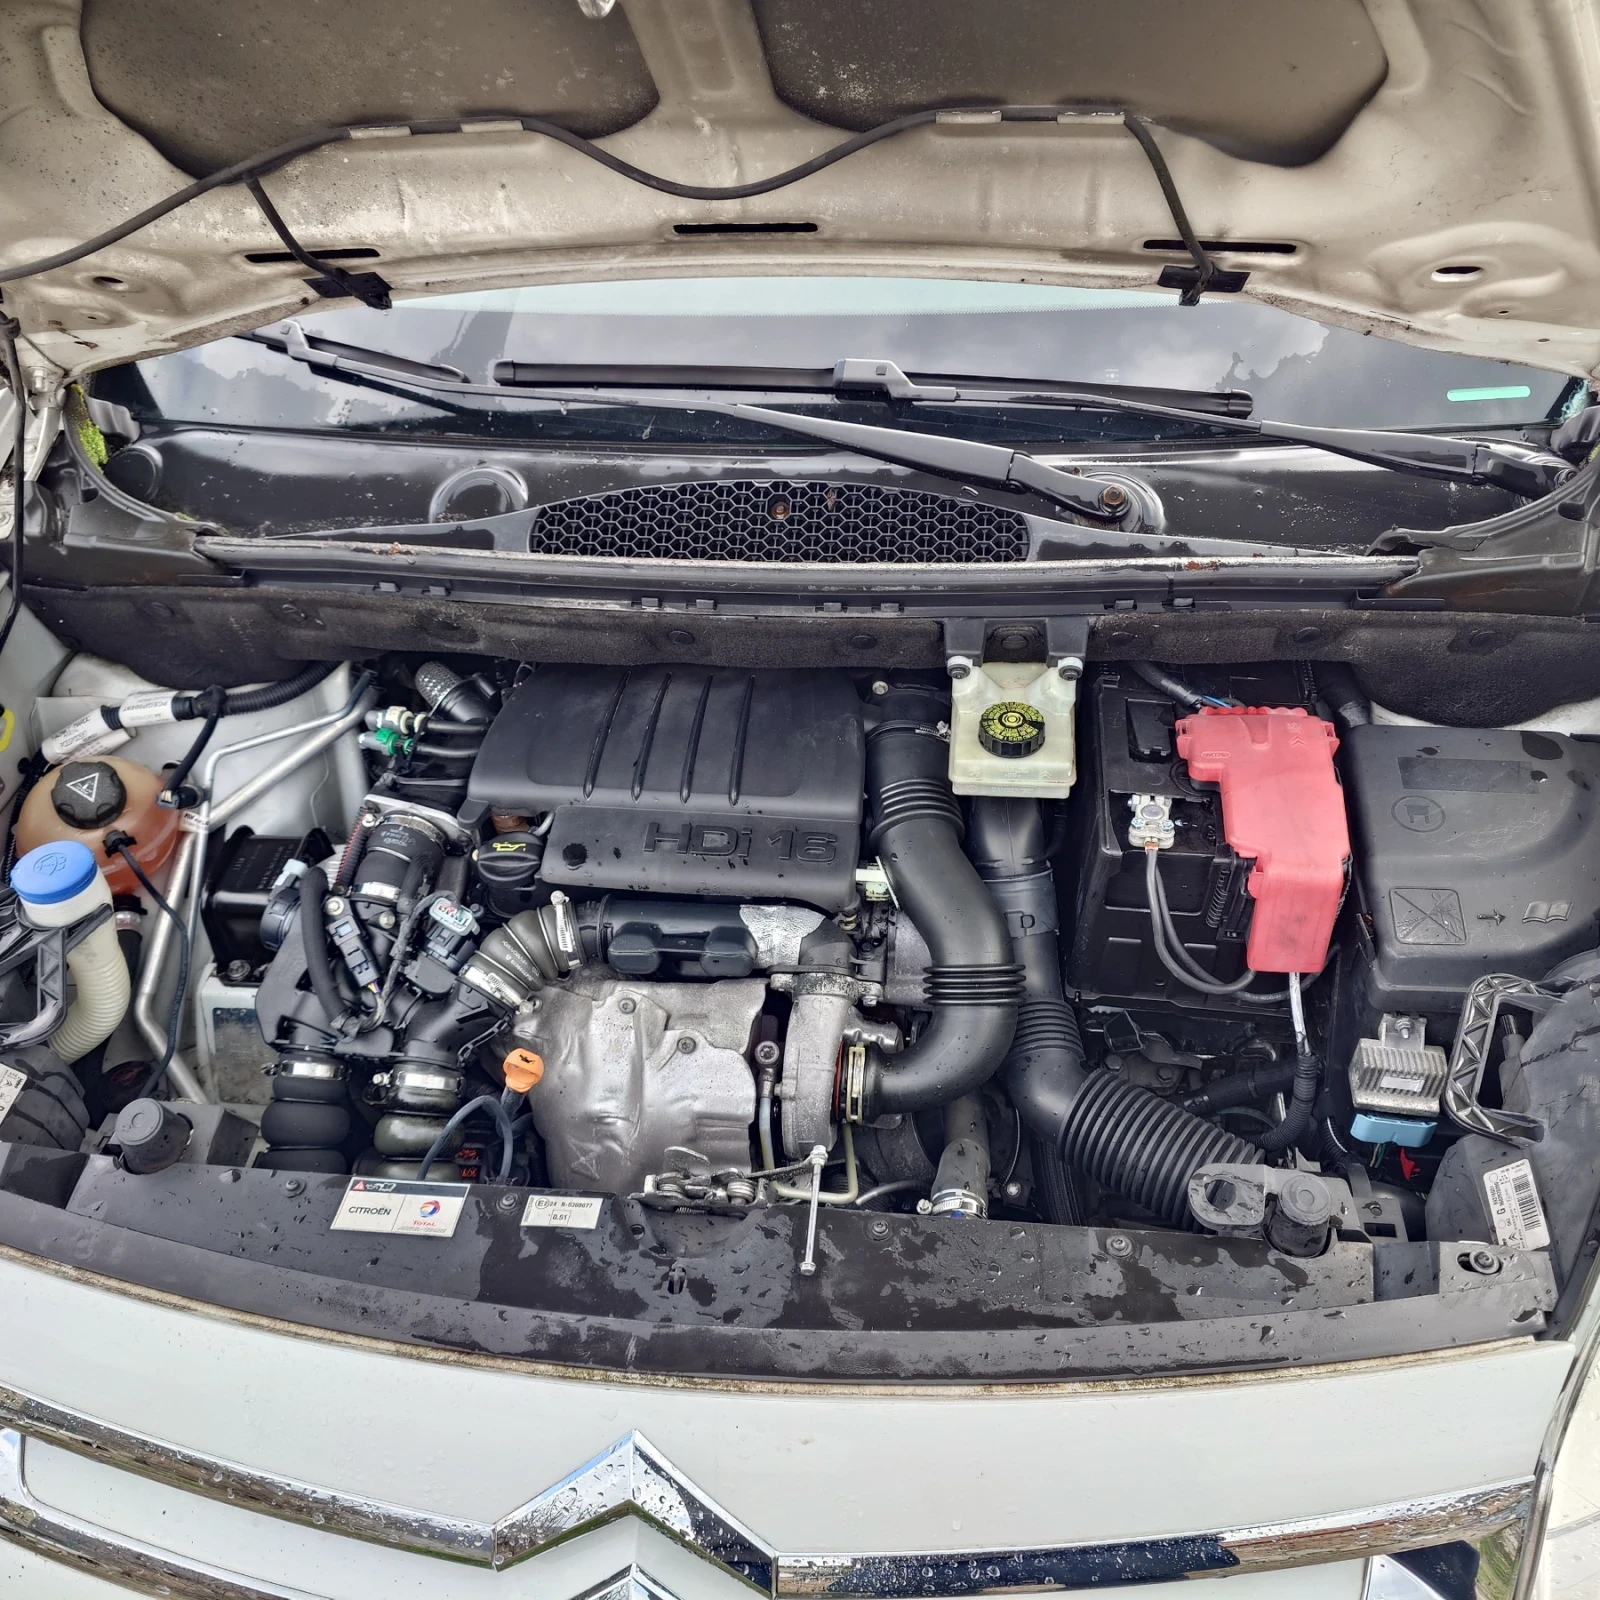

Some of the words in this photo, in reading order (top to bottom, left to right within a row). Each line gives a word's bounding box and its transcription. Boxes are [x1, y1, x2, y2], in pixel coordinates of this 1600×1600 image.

[643, 822, 752, 857] HDi
[765, 828, 838, 863] 16
[348, 1206, 392, 1216] CITROËN
